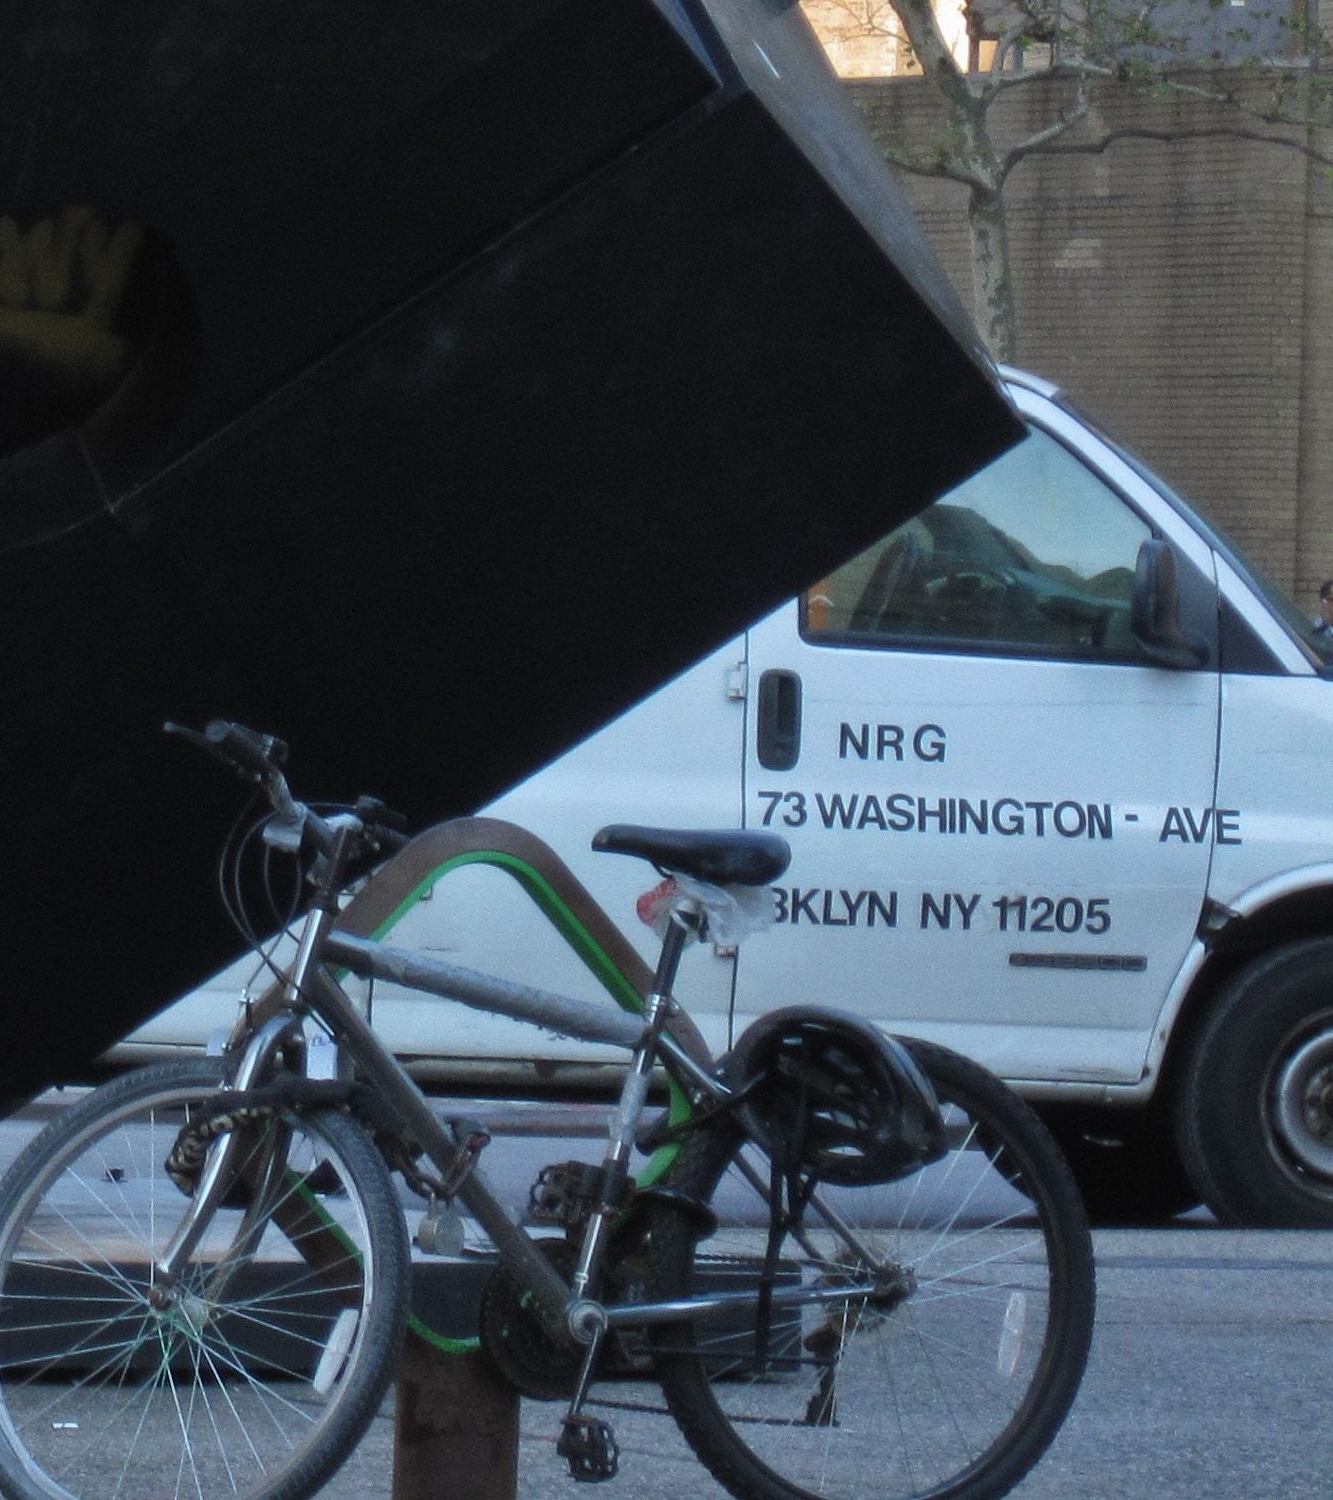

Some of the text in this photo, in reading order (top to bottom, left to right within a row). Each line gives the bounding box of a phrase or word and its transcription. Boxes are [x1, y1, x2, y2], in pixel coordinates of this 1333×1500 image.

[837, 722, 947, 763] NRG
[757, 790, 808, 828] 73
[814, 792, 1114, 840] WASHINGTON
[1158, 806, 1243, 846] AVE
[920, 892, 982, 930] NY
[992, 896, 1112, 934] 11205
